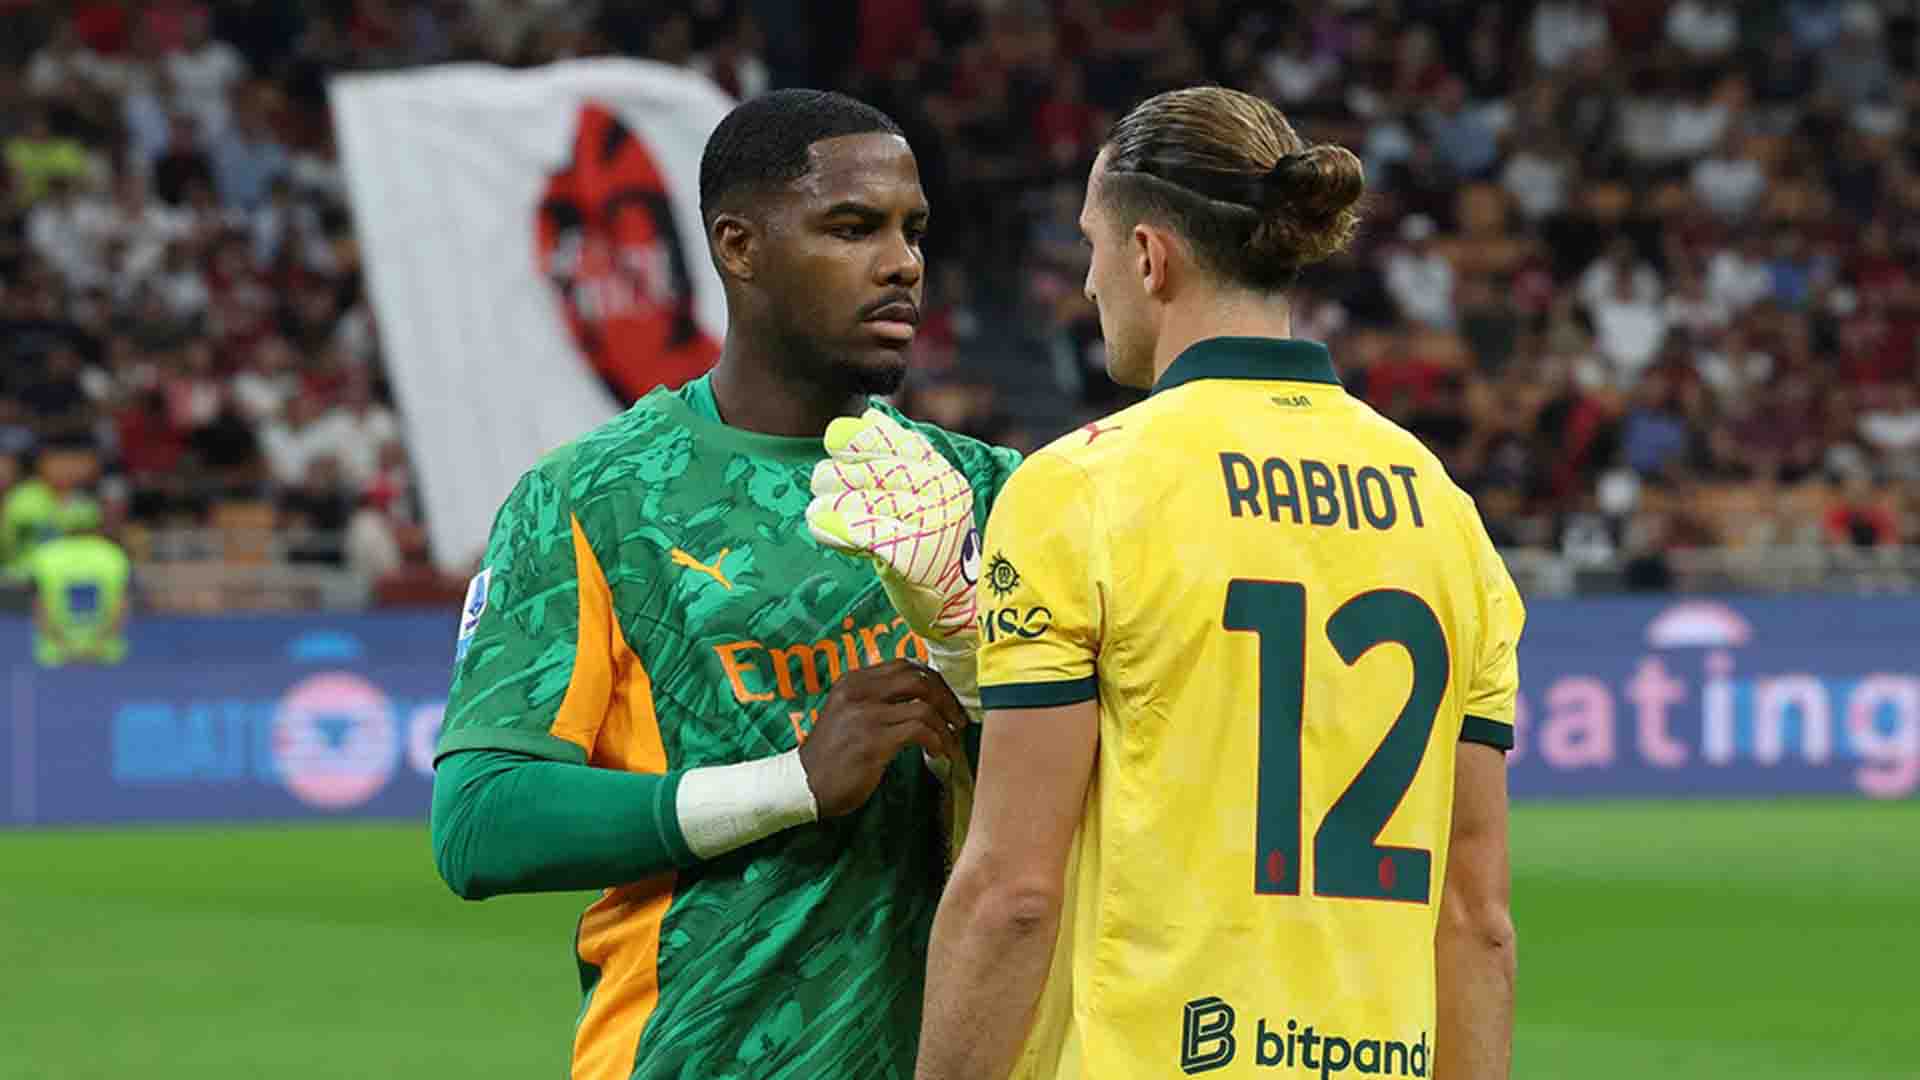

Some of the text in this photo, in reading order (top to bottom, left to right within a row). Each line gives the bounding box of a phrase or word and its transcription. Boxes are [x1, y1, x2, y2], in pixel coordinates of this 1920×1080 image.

[1219, 452, 1425, 531] RABIOT
[1222, 578, 1450, 905] 12
[1255, 1017, 1431, 1080] bitpand
